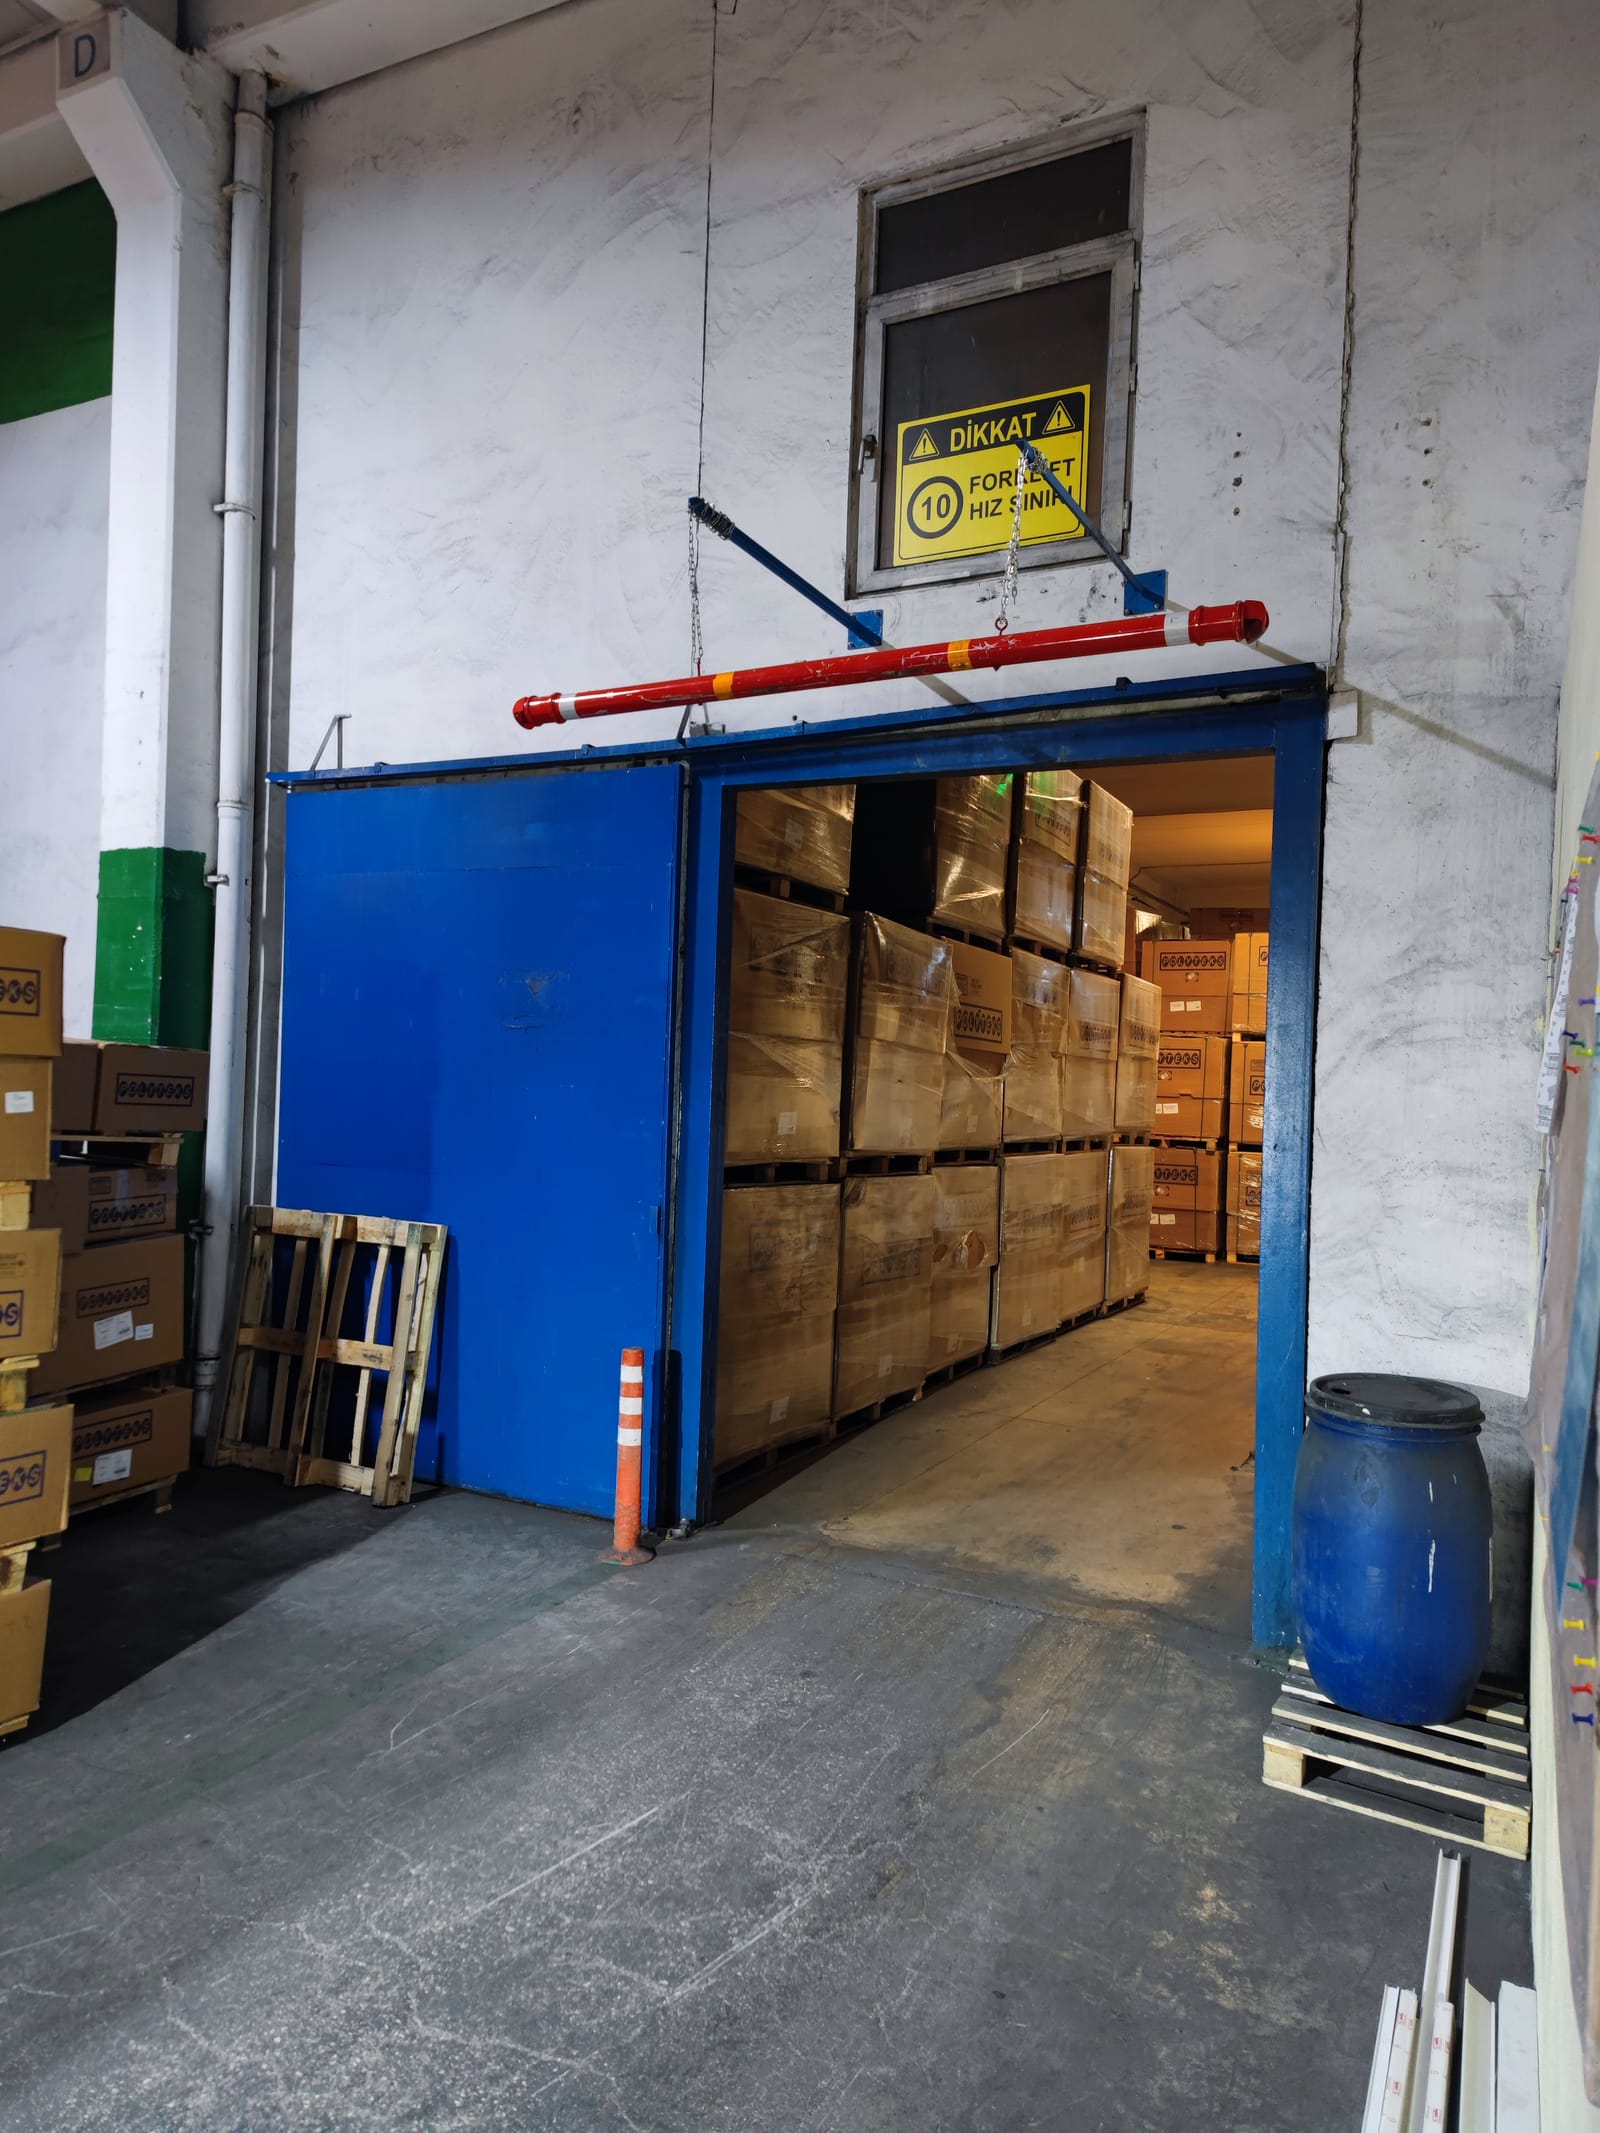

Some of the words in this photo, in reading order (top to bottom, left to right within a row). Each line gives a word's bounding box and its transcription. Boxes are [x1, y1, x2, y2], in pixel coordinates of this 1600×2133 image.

[75, 34, 96, 78] D
[950, 412, 1037, 452] DİKKAT
[921, 494, 951, 521] 10
[970, 498, 1003, 521] HIZ
[1161, 955, 1225, 968] POLYTEKS
